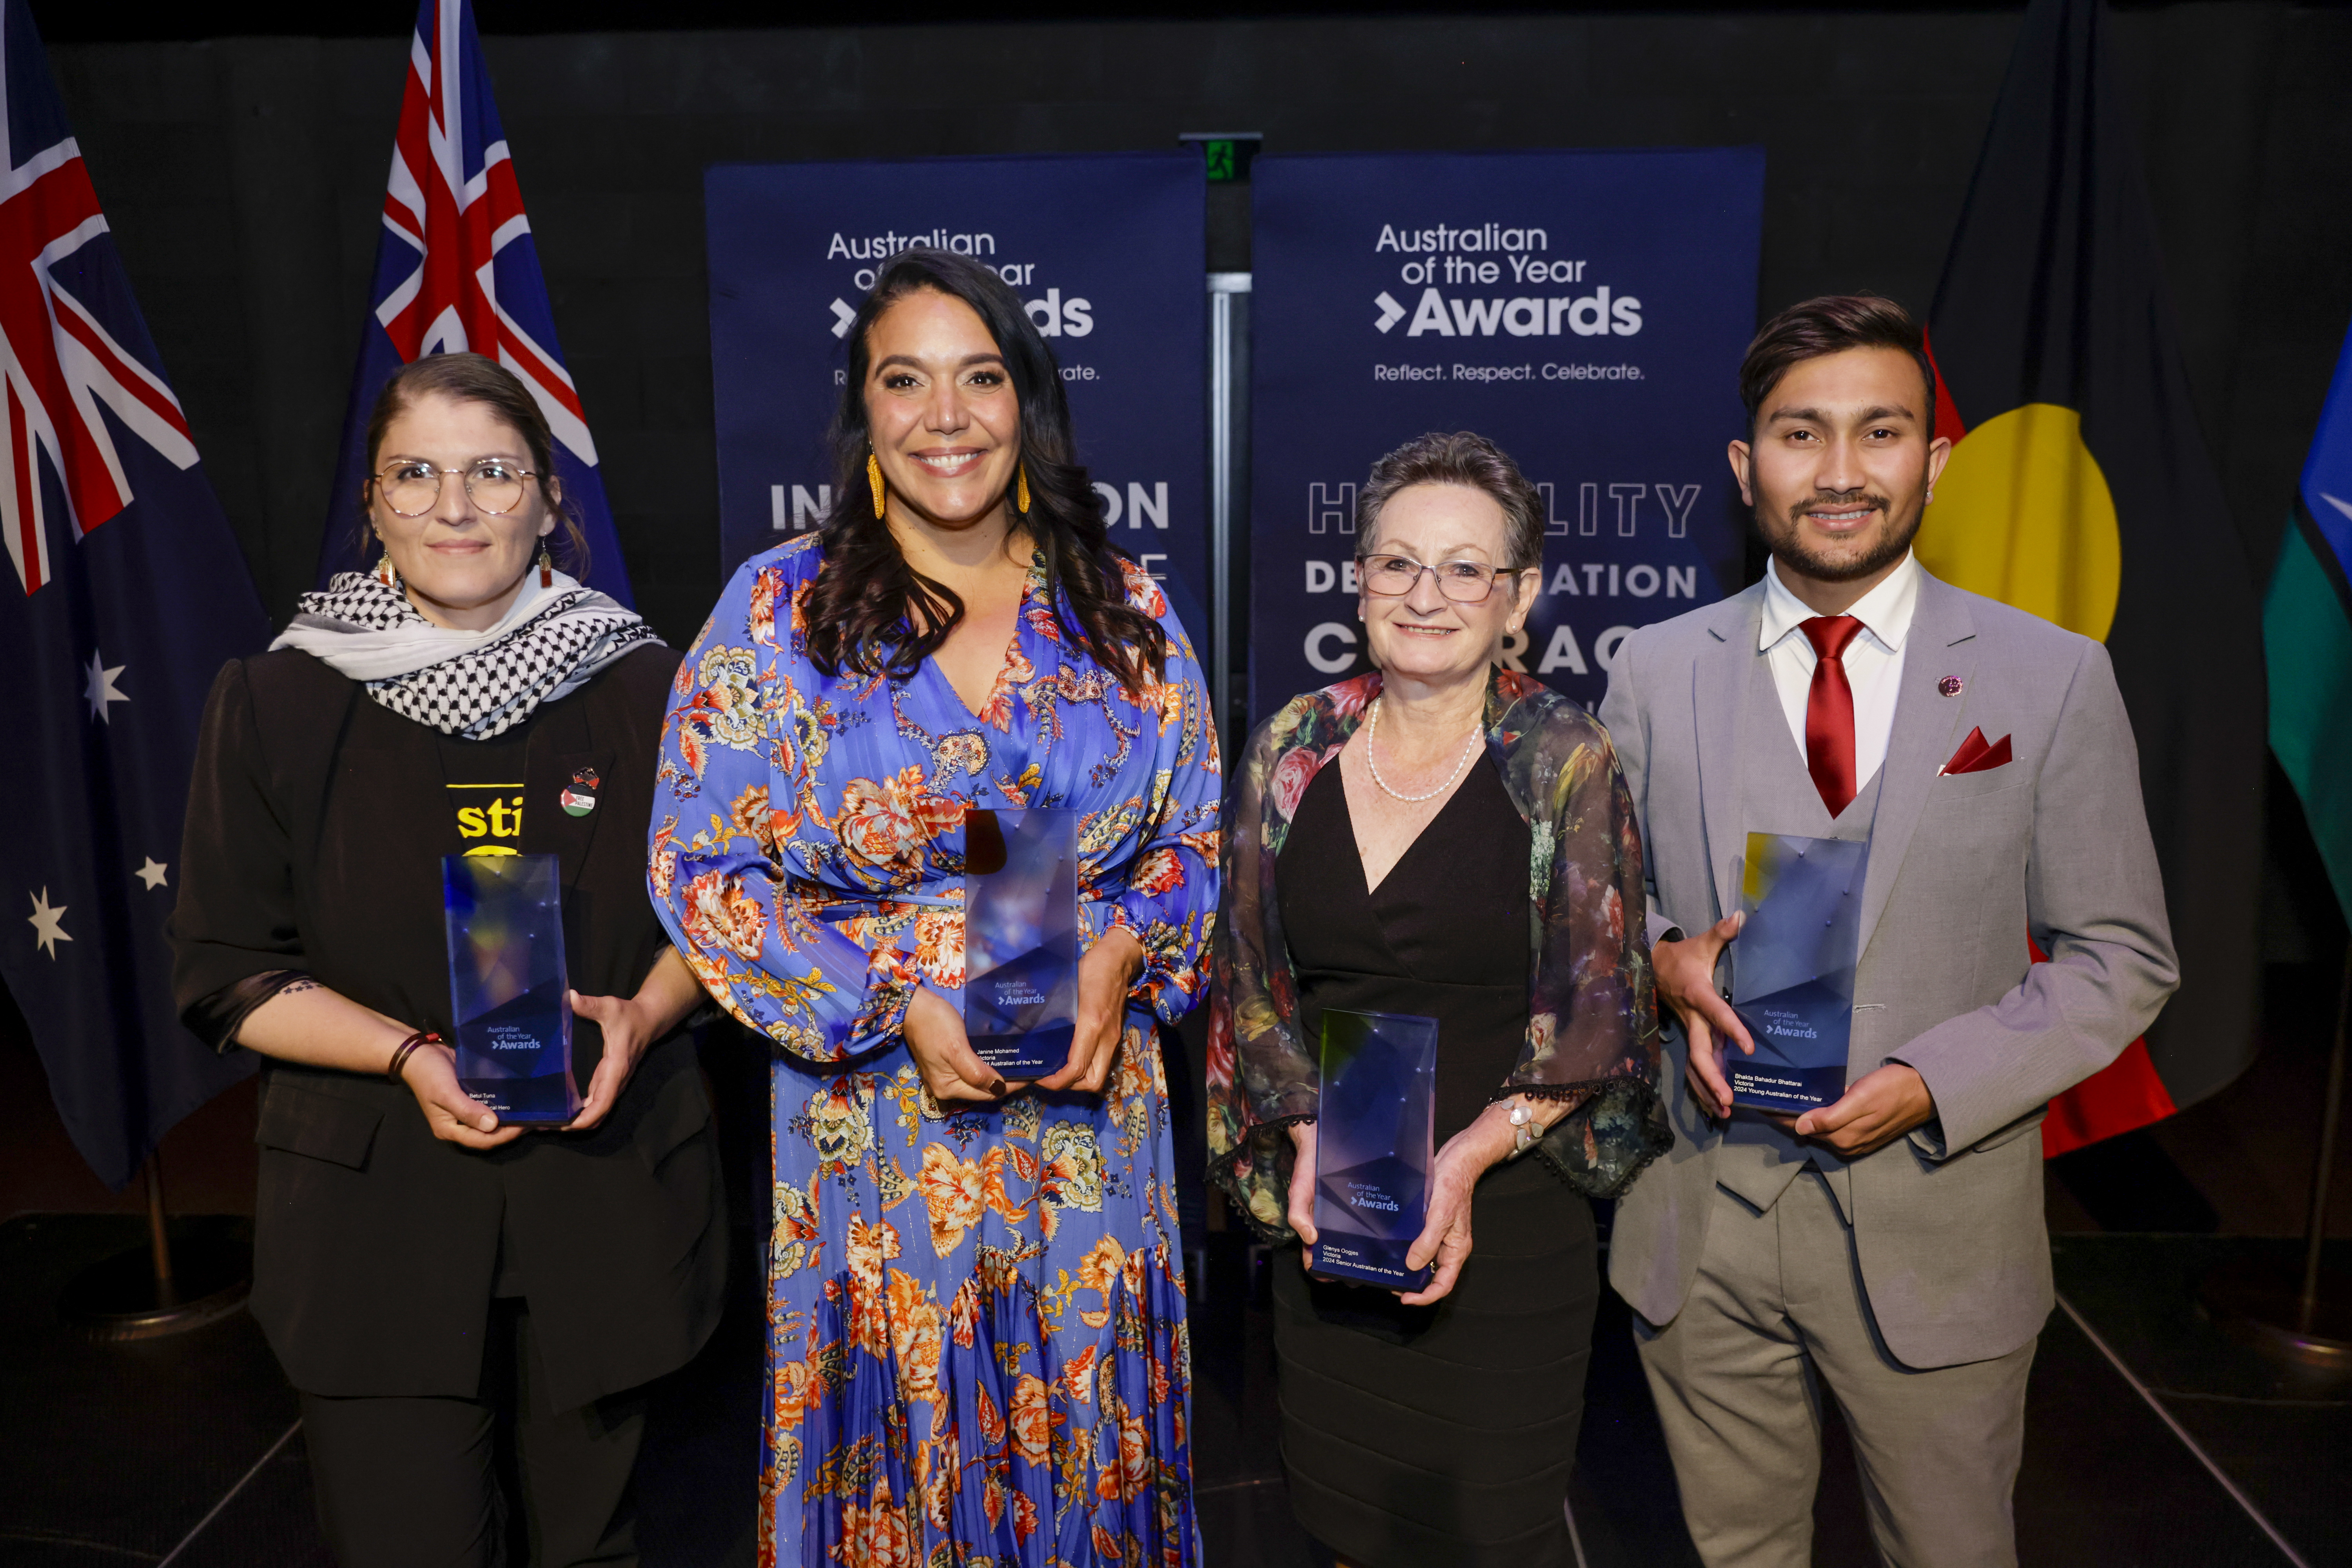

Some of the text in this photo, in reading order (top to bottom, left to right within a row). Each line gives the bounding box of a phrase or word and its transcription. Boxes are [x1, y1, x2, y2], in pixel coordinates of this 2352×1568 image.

[1375, 223, 1547, 252] Australian
[1401, 254, 1586, 285] of the Year
[1406, 286, 1643, 337] Awards
[1374, 363, 1645, 384] Reflect. Respect. Celebrate.
[1005, 993, 1045, 1005] Awards
[1764, 1009, 1798, 1019] Australian
[1773, 1025, 1817, 1038] Awards
[500, 1039, 541, 1049] Awards
[1348, 1182, 1379, 1192] Australian
[1357, 1197, 1399, 1211] Awards
[1352, 1263, 1377, 1272] Australian
